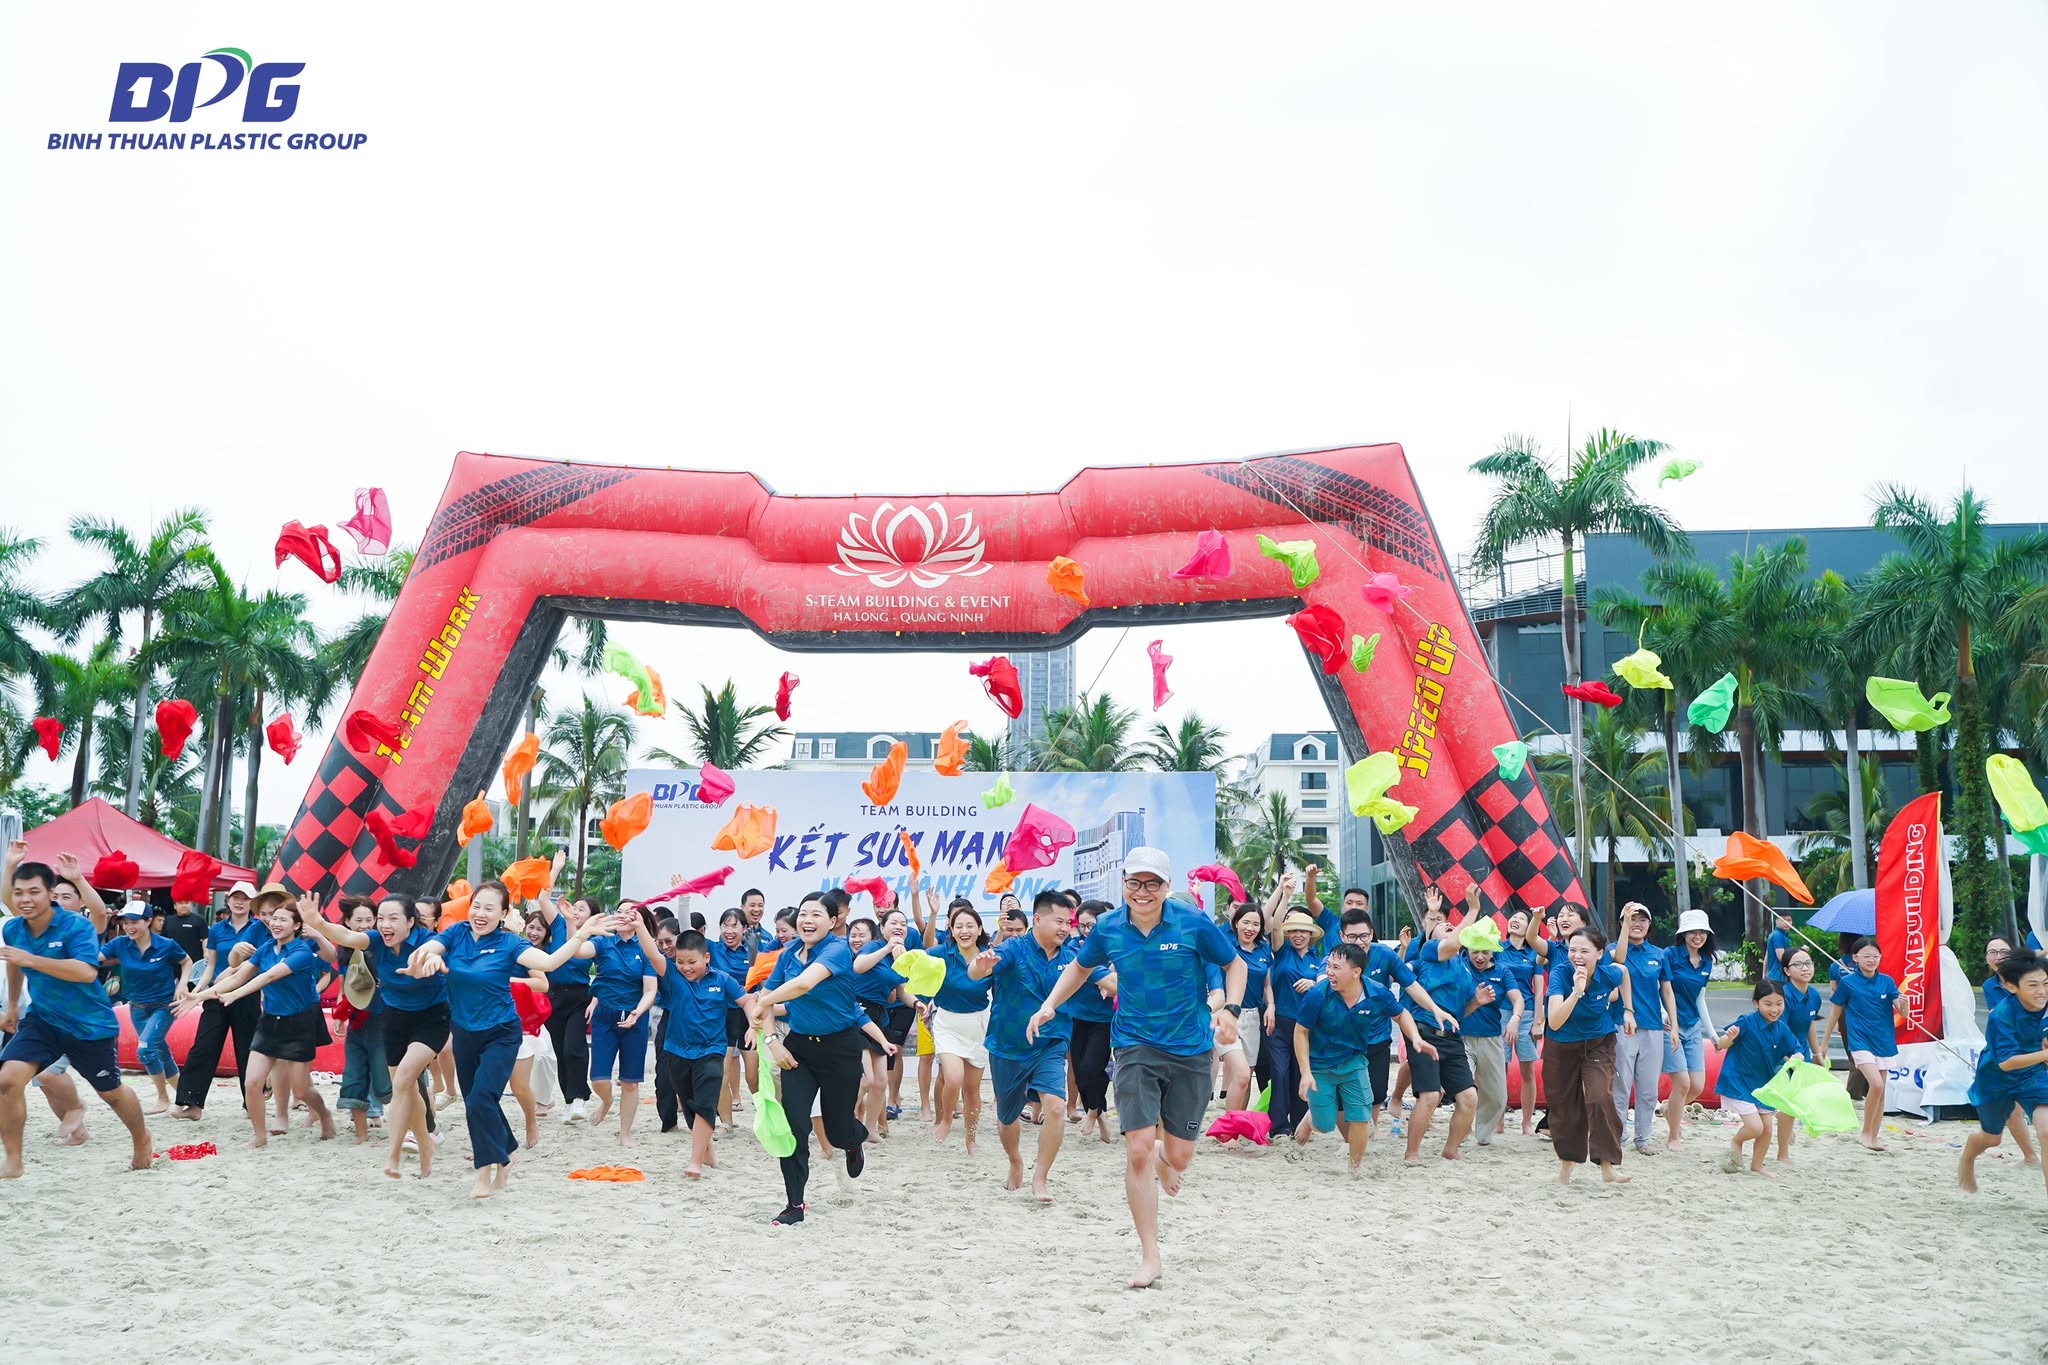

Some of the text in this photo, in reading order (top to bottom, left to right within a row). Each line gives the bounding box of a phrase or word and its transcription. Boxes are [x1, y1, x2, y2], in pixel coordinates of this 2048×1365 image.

[805, 594, 1011, 609] S-TEAM BUILDING & EVENT
[833, 612, 851, 622] HA
[855, 612, 889, 622] LONG
[900, 612, 946, 623] QUANG
[950, 612, 984, 622] NINH
[417, 584, 483, 681] WORK
[1413, 622, 1458, 676] UP
[860, 805, 977, 817] TEAM BUILDING
[768, 822, 850, 876] KẾT
[930, 830, 1012, 871] MẠN
[1904, 823, 1926, 1030] TEAMBUILDING
